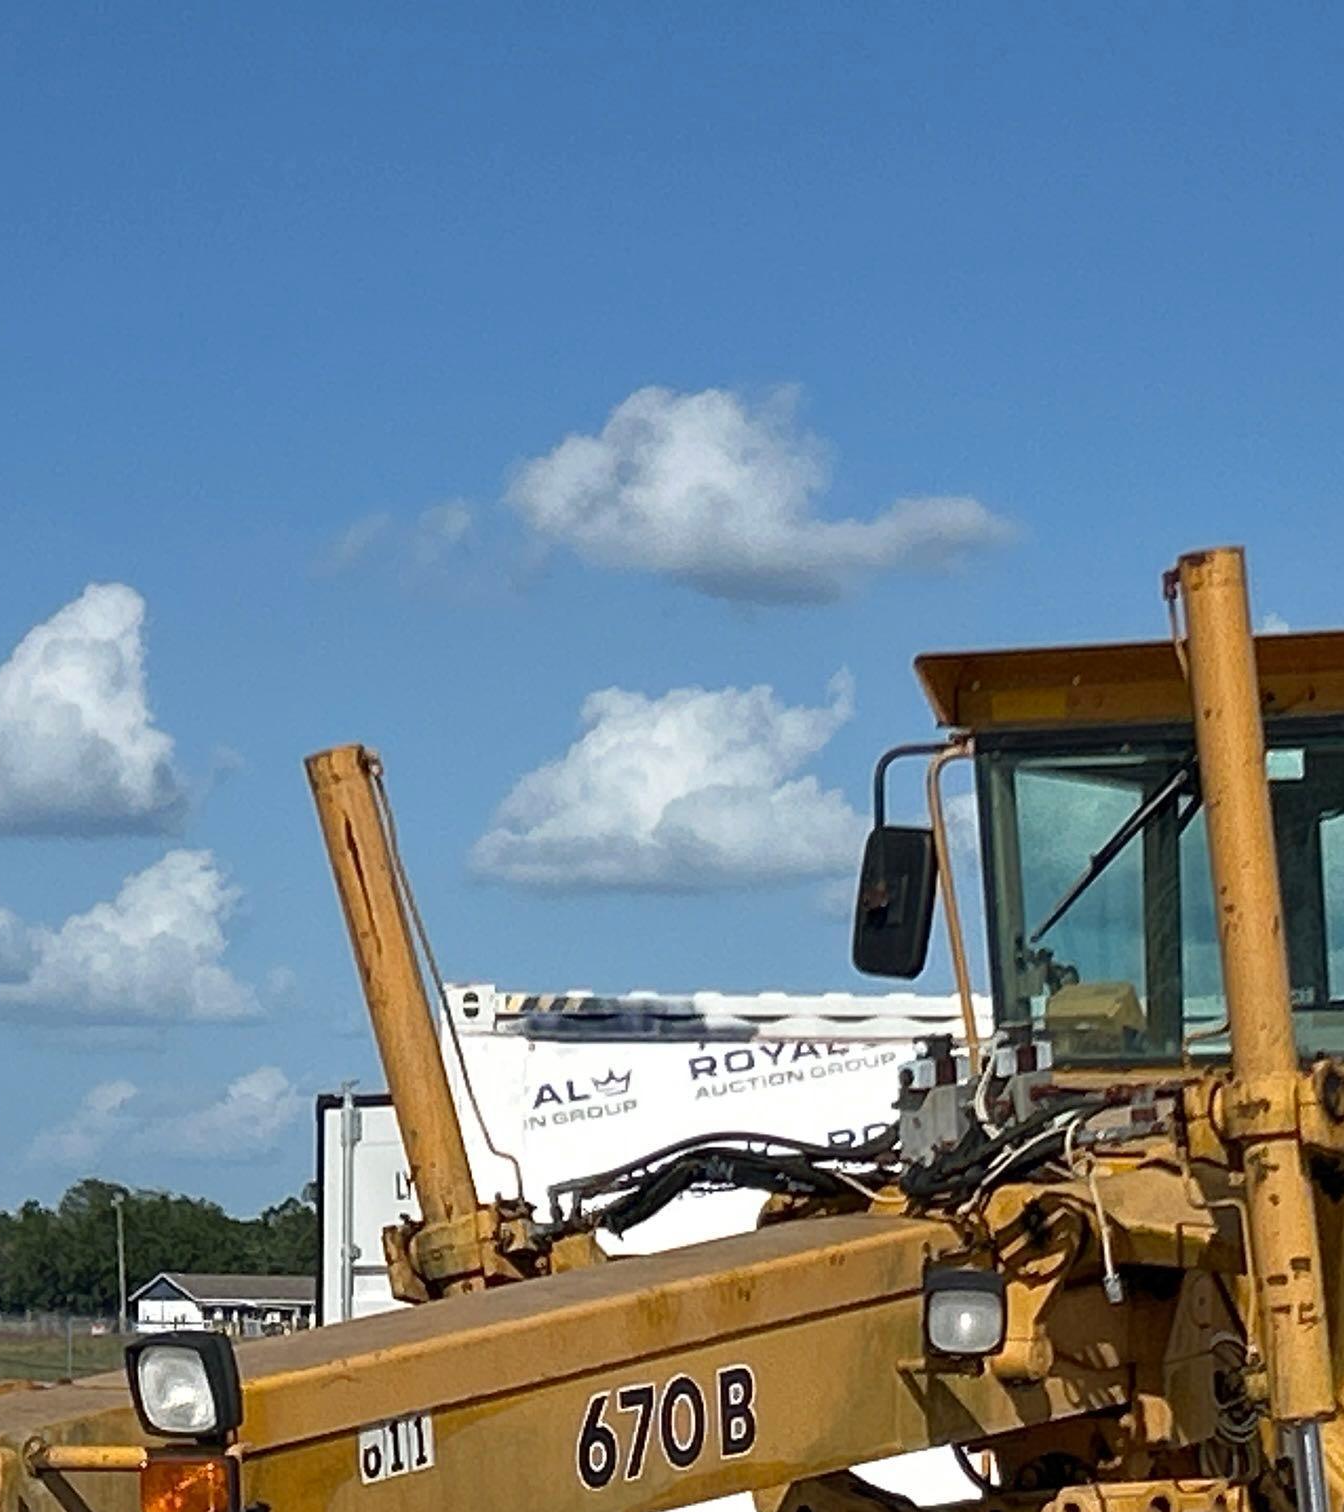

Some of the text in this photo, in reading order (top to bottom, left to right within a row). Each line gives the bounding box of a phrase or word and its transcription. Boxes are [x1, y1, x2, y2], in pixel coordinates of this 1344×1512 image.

[695, 1051, 898, 1100] AUCTION GROUP
[551, 1099, 638, 1125] GROUP
